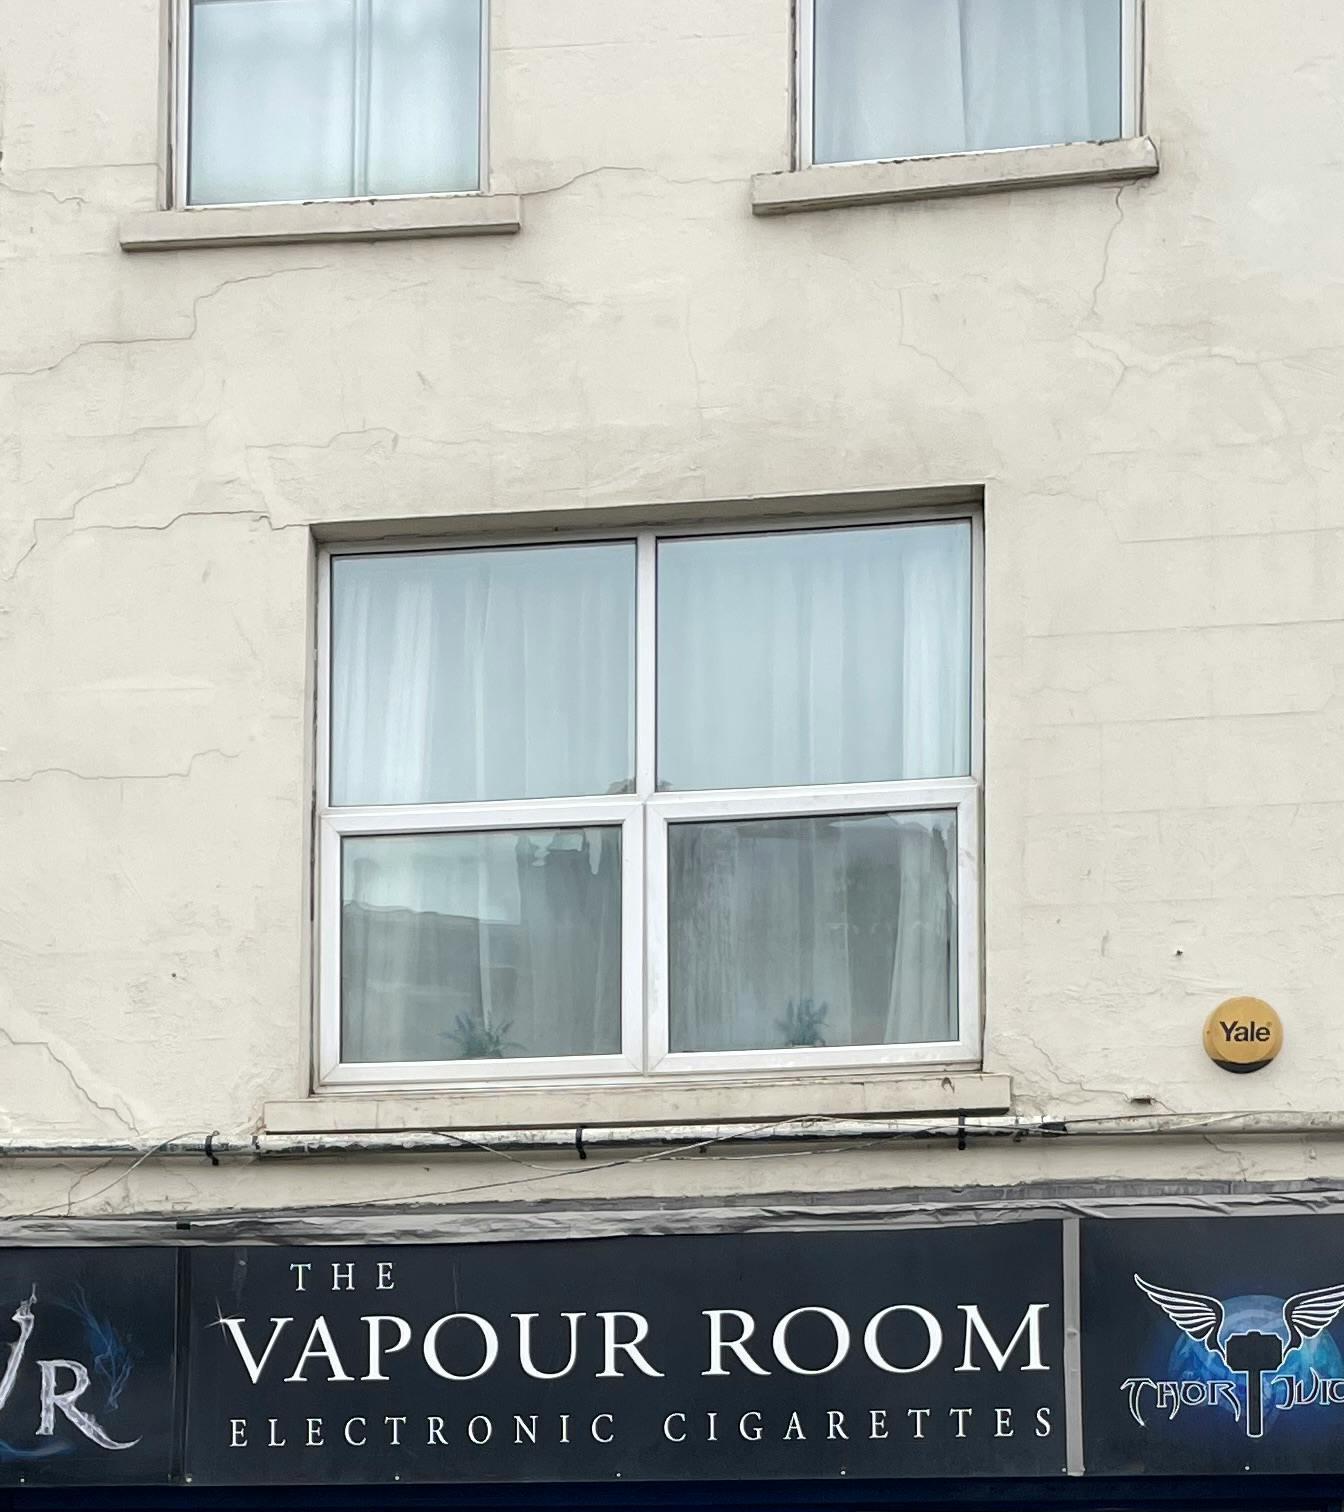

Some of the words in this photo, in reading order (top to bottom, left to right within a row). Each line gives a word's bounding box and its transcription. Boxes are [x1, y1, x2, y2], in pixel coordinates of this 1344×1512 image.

[1219, 1021, 1271, 1042] Yale
[290, 1261, 396, 1292] THE
[222, 1309, 665, 1385] VAPOUR
[701, 1302, 1053, 1378] ROOM
[230, 1412, 615, 1449] ELECTRONIC
[663, 1406, 1054, 1444] CIGARETTES
